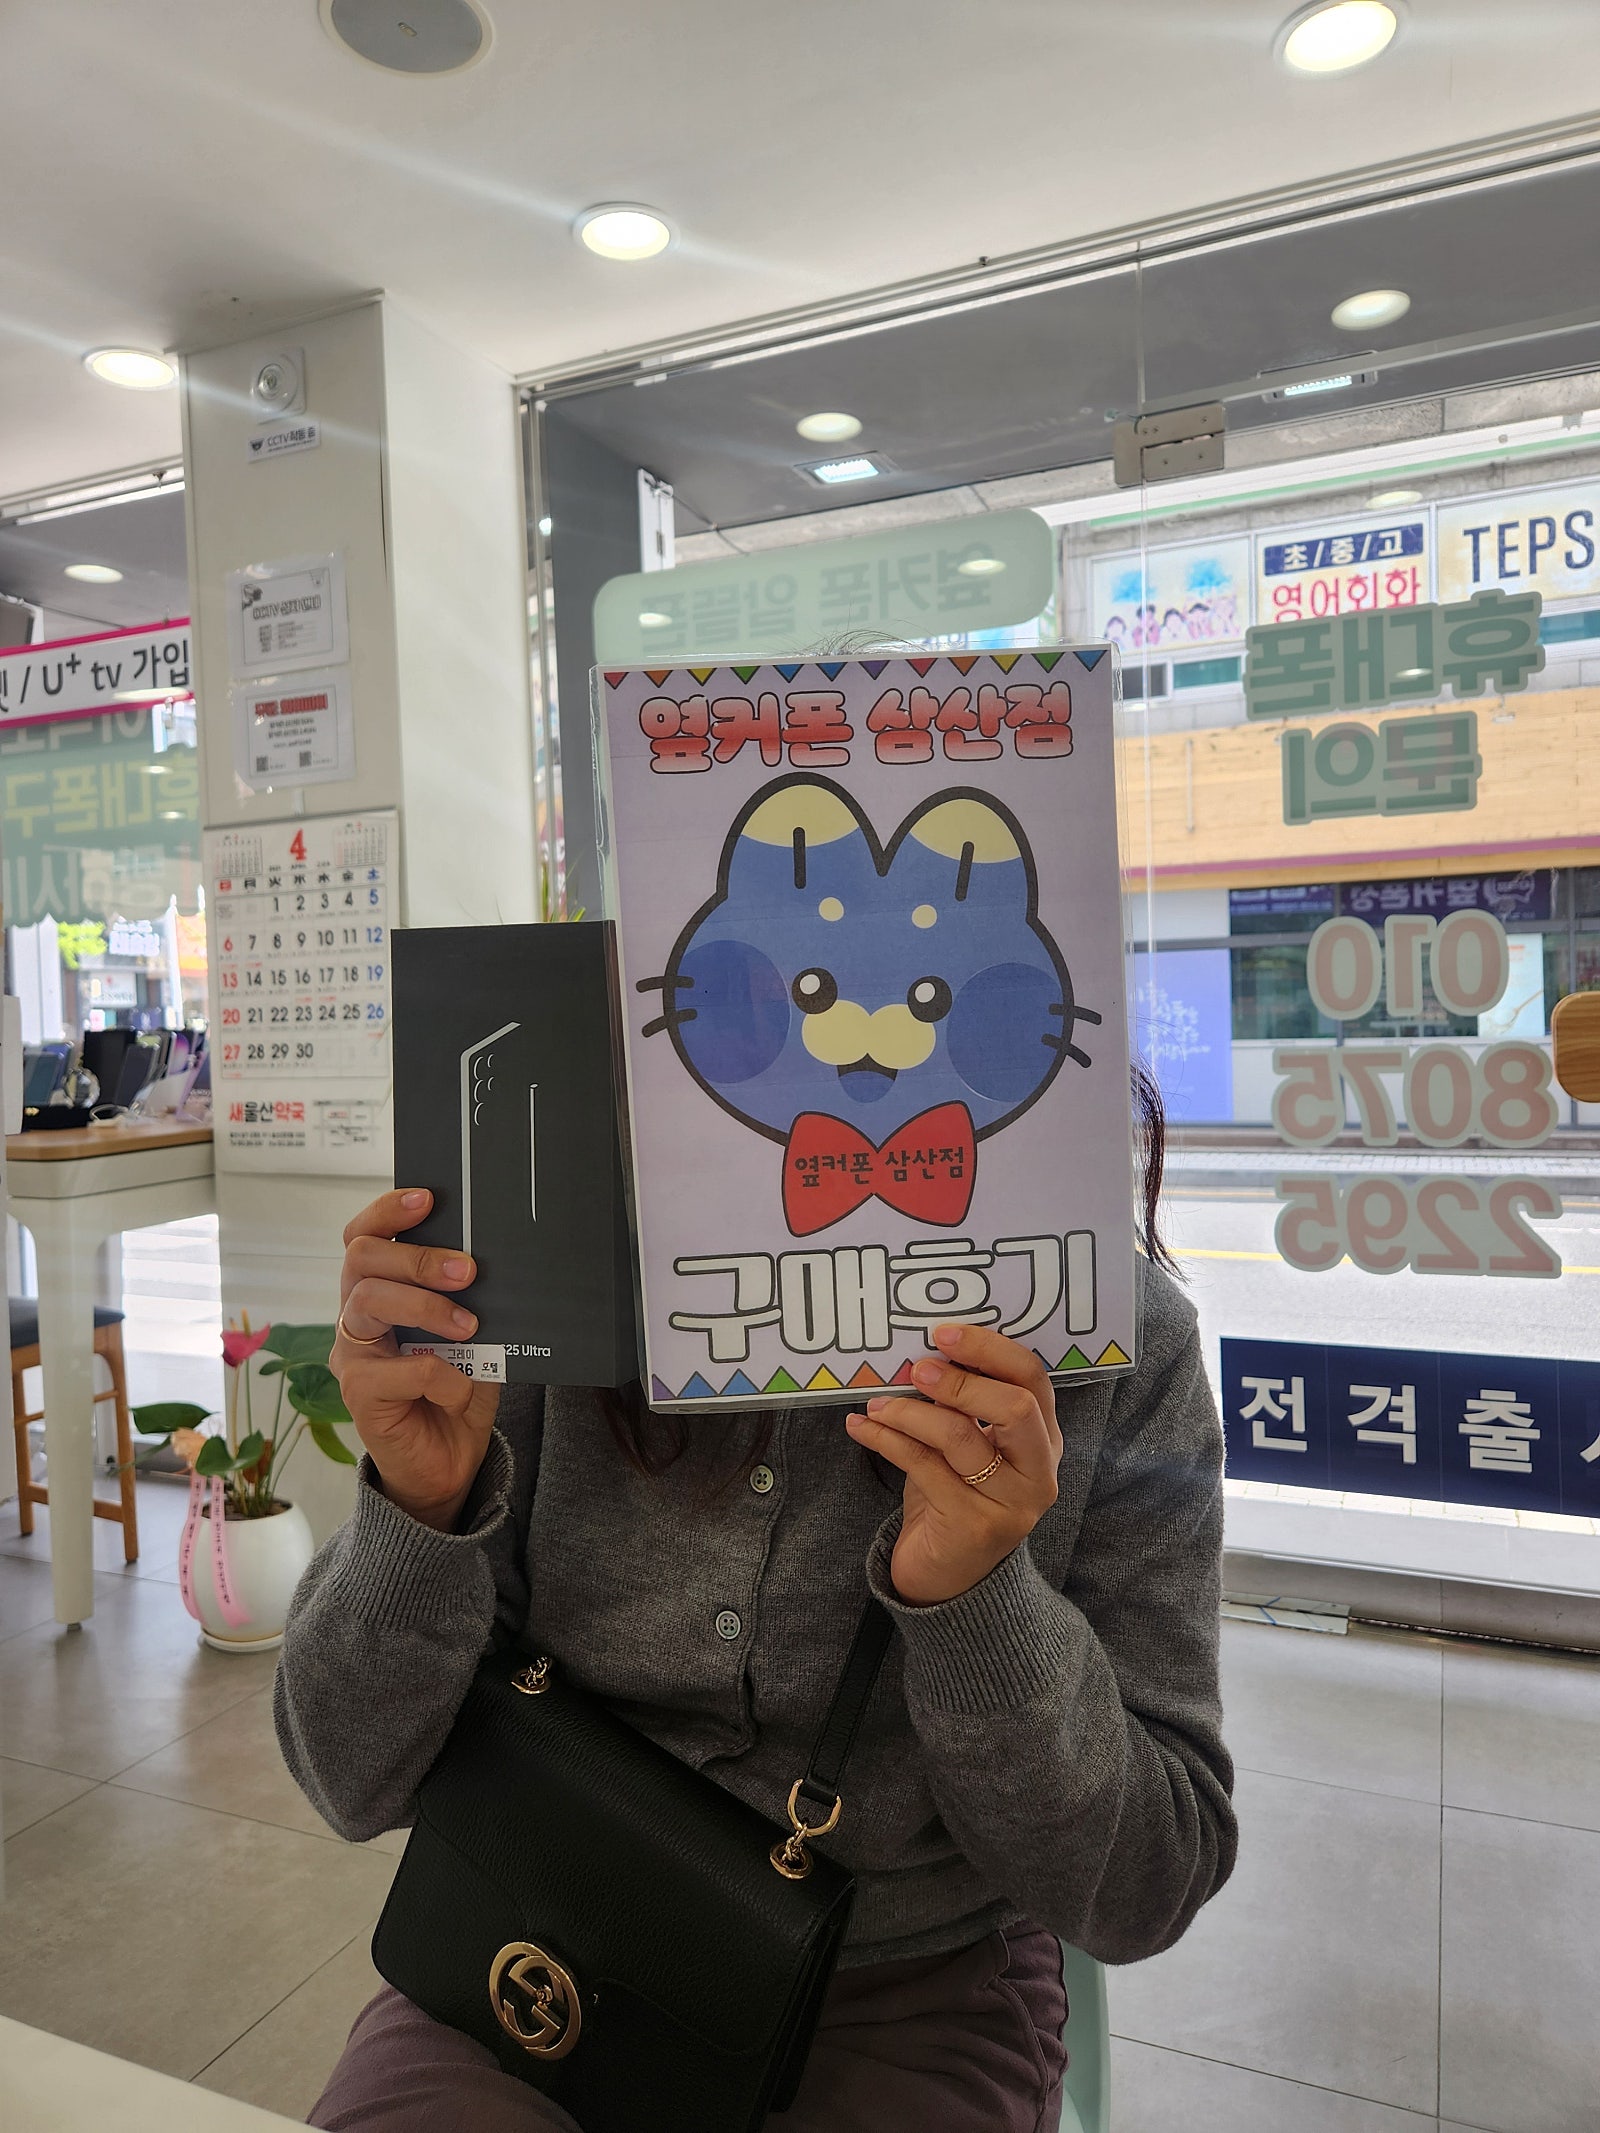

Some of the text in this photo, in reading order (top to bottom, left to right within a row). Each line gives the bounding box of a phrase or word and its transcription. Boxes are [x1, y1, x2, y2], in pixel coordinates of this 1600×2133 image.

[1283, 529, 1404, 572] 초/중/고
[1464, 510, 1595, 583] TEPS
[1273, 566, 1421, 622] 영어회화
[90, 662, 122, 690] tv
[133, 640, 190, 688] 가입
[639, 681, 1074, 774] 옆커폰 삼산점
[289, 828, 307, 861] 4
[274, 889, 378, 912] 1 2 3 4 5
[224, 927, 382, 952] 6 7 8 9 10 11 12
[222, 965, 383, 988] 13 14 15 16 17 18 19
[223, 1003, 384, 1024] 20 21 22 23 24 25 26
[224, 1044, 240, 1060] 27
[248, 1044, 265, 1060] 28
[272, 1043, 289, 1059] 29
[296, 1043, 314, 1058] 30
[794, 1146, 965, 1188] 옆커폰 삼산점
[669, 1229, 1097, 1364] 구매후기
[447, 1349, 474, 1360] 그레이
[502, 1344, 551, 1358] 25 Ultra
[449, 1362, 474, 1377] 36
